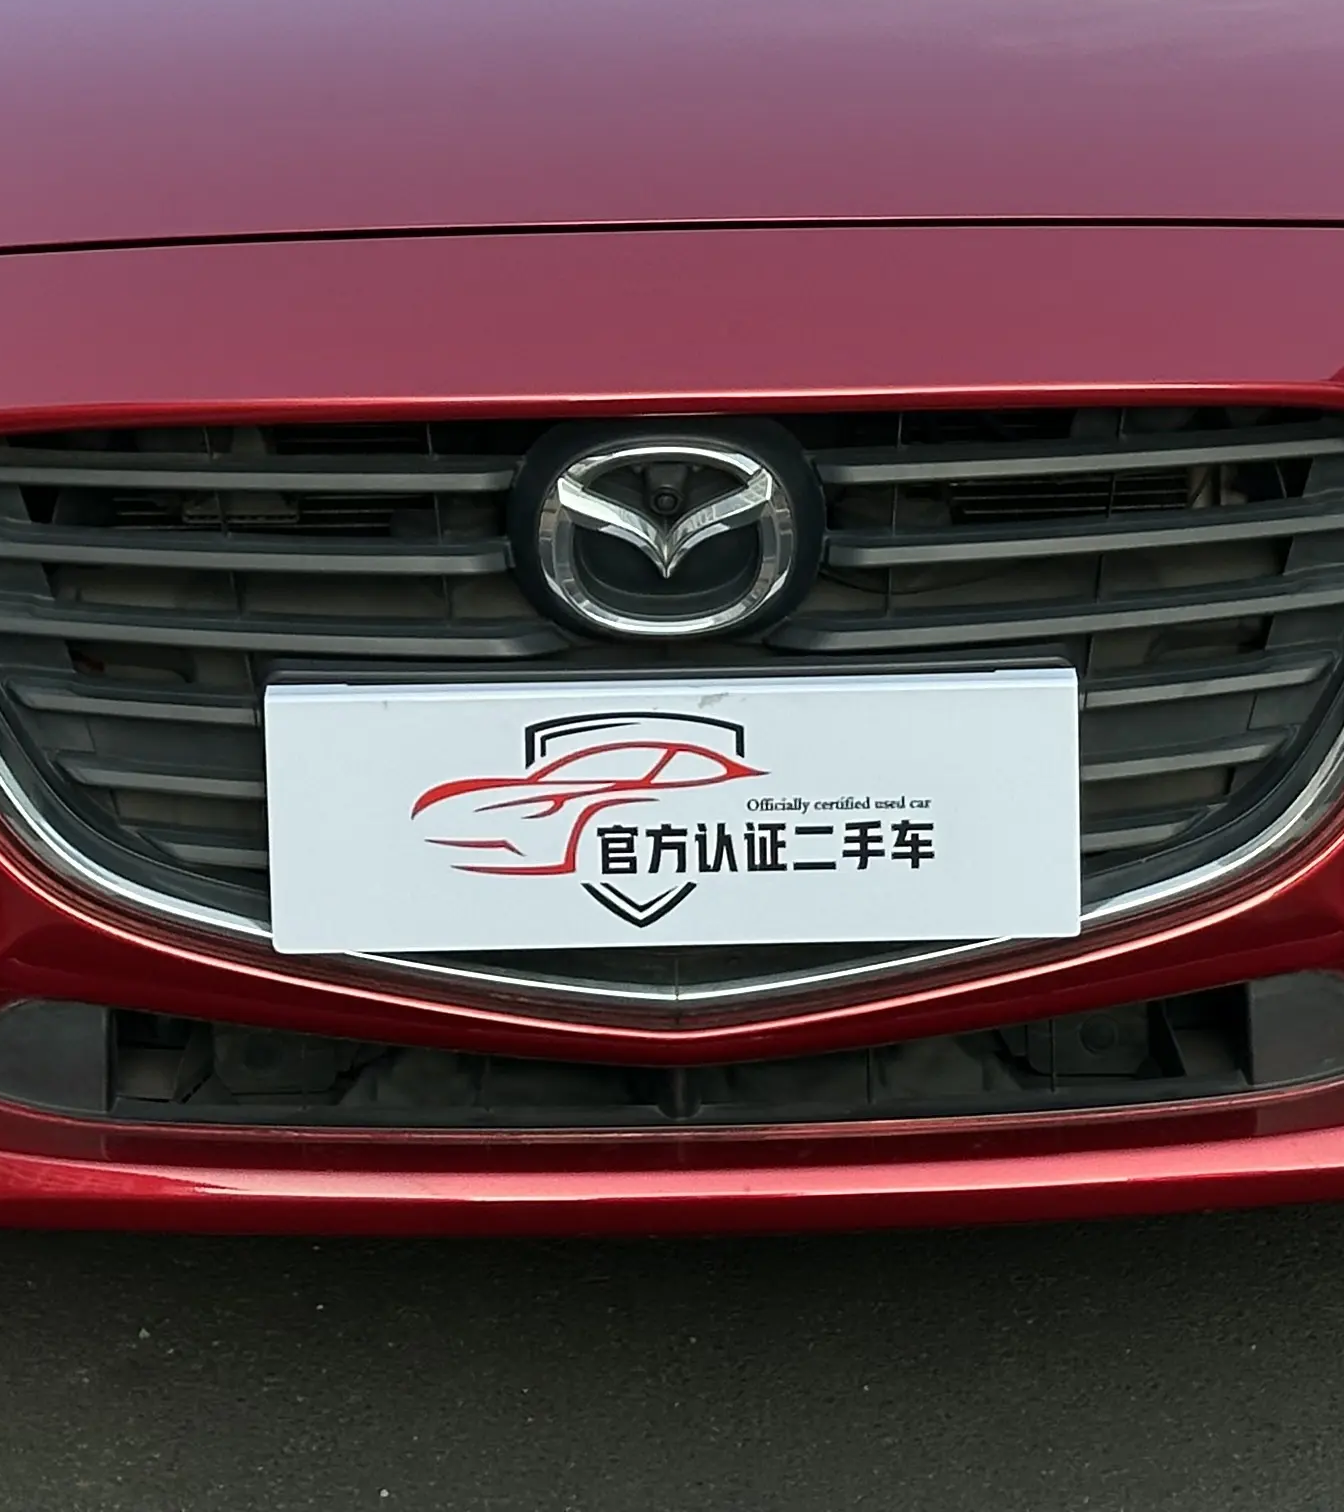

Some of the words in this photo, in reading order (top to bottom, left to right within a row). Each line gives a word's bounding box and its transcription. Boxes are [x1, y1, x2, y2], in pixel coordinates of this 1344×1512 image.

[746, 798, 810, 814] Officially
[814, 796, 870, 810] certified
[875, 796, 905, 809] used
[909, 798, 932, 809] car
[596, 819, 936, 875] 官方认证二手车
